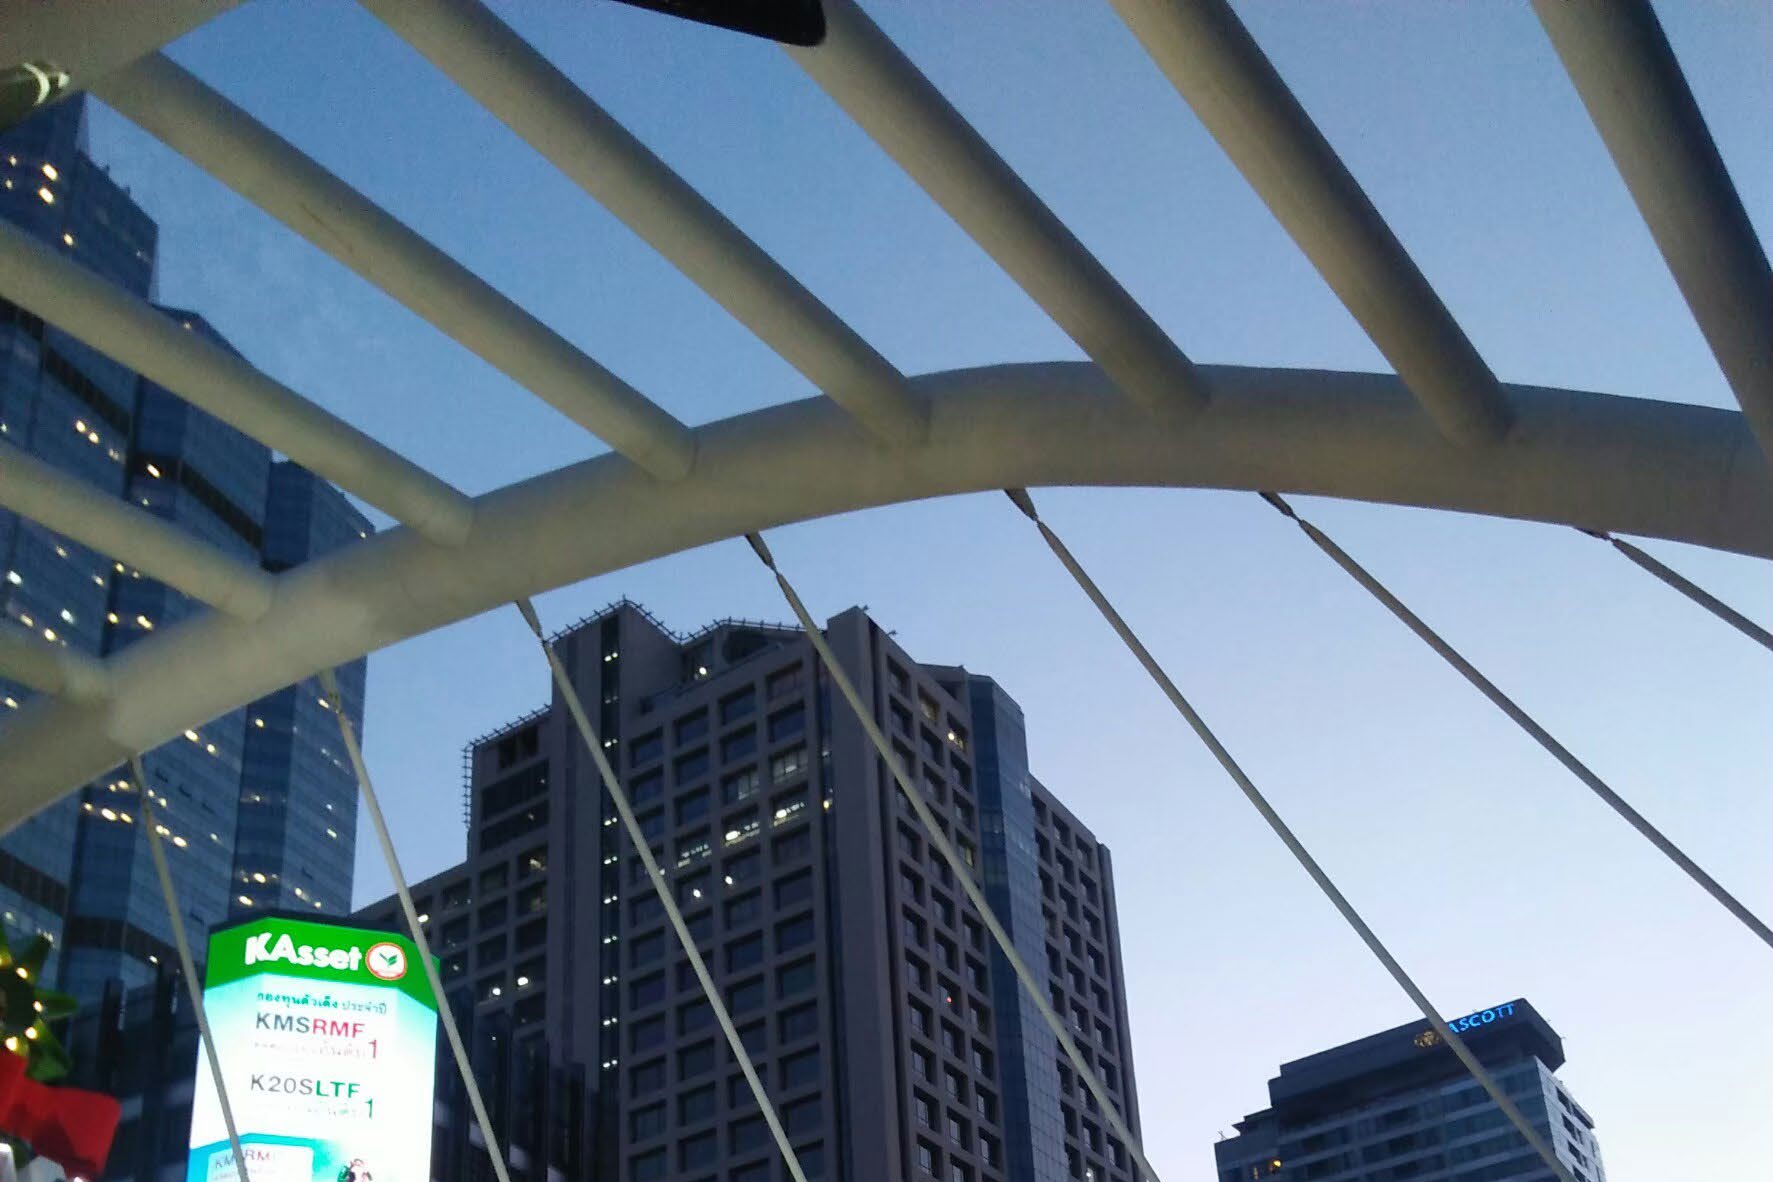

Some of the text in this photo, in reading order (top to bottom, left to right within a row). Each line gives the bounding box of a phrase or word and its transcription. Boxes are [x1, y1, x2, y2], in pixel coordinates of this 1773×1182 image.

[245, 932, 362, 971] KAsset
[256, 1012, 365, 1038] KMSRMF
[368, 1039, 377, 1059] 1
[250, 1074, 361, 1098] K20SLTF
[365, 1098, 373, 1119] 1
